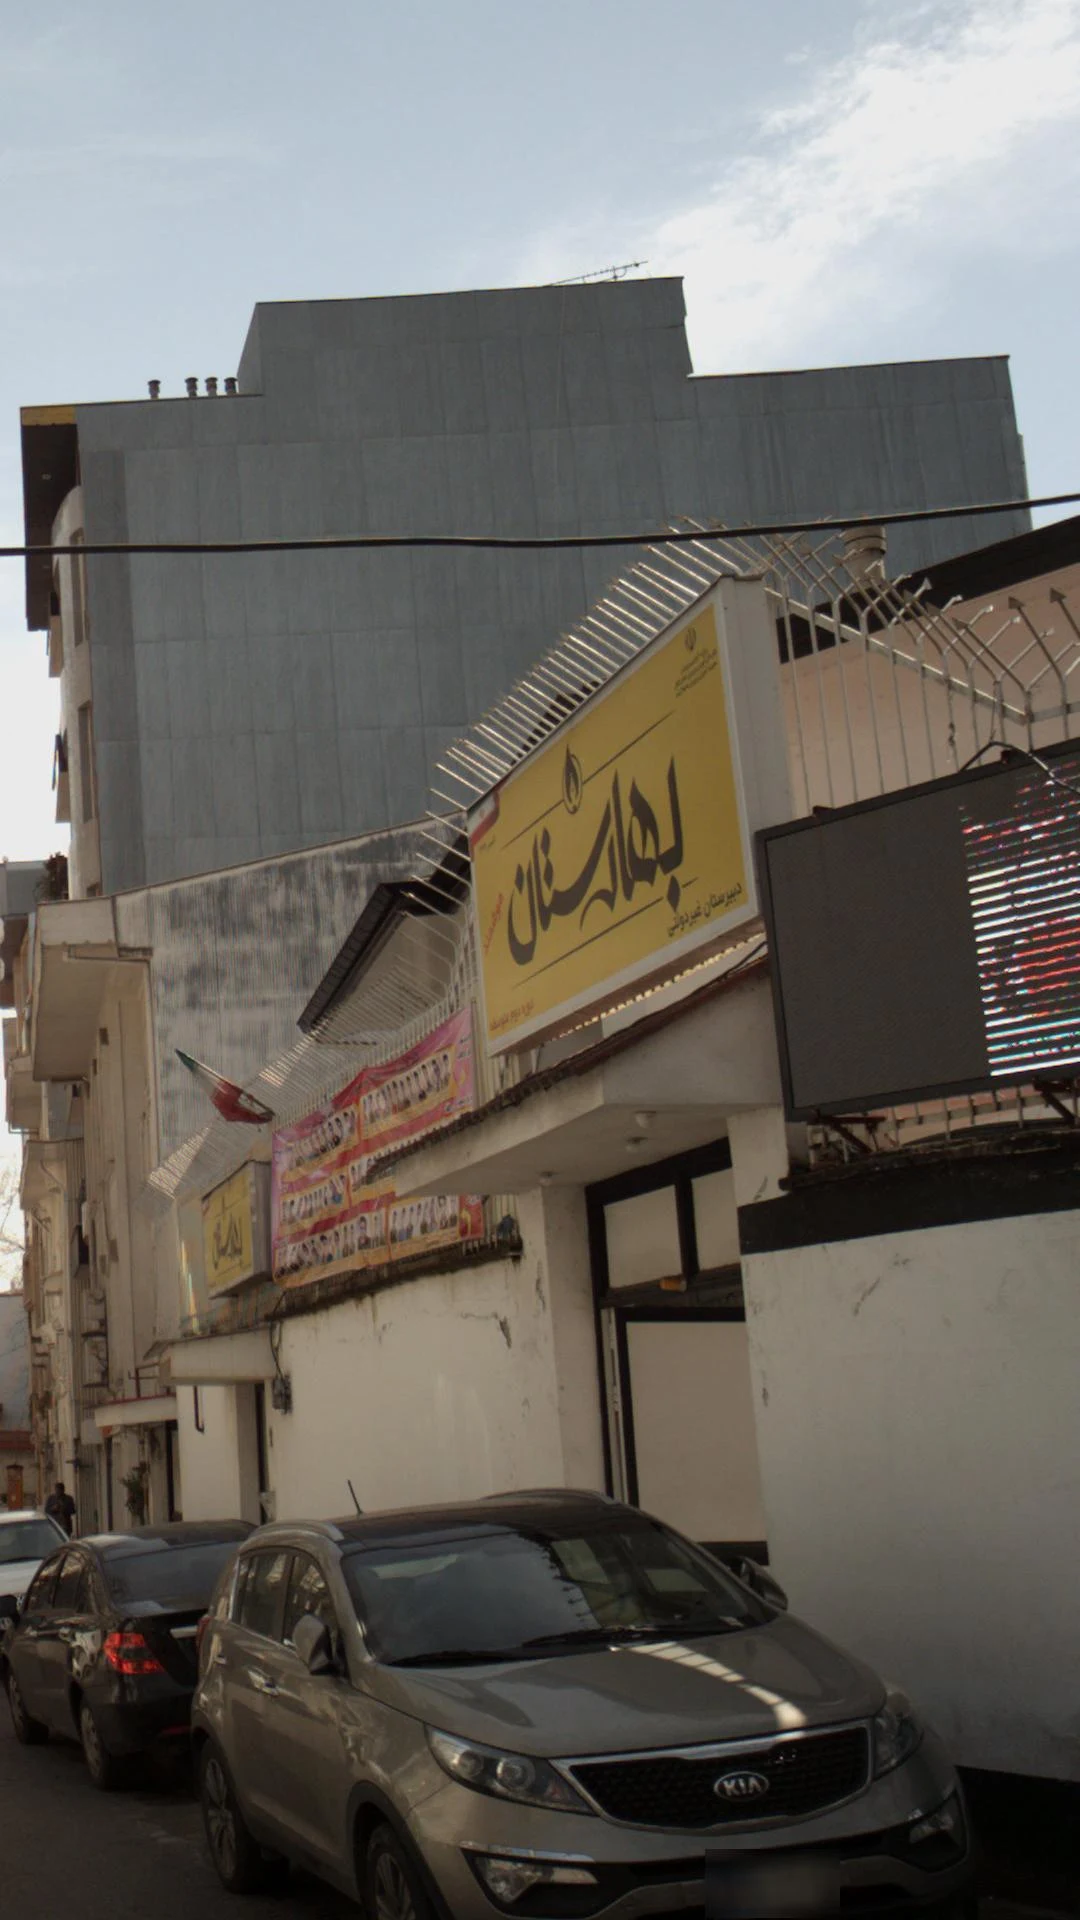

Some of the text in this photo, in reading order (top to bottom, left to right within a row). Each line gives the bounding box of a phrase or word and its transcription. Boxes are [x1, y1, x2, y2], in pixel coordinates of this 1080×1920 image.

[507, 754, 684, 966] بهارستان
[703, 882, 743, 918] دبیرستان
[722, 1776, 762, 1797] KIA
